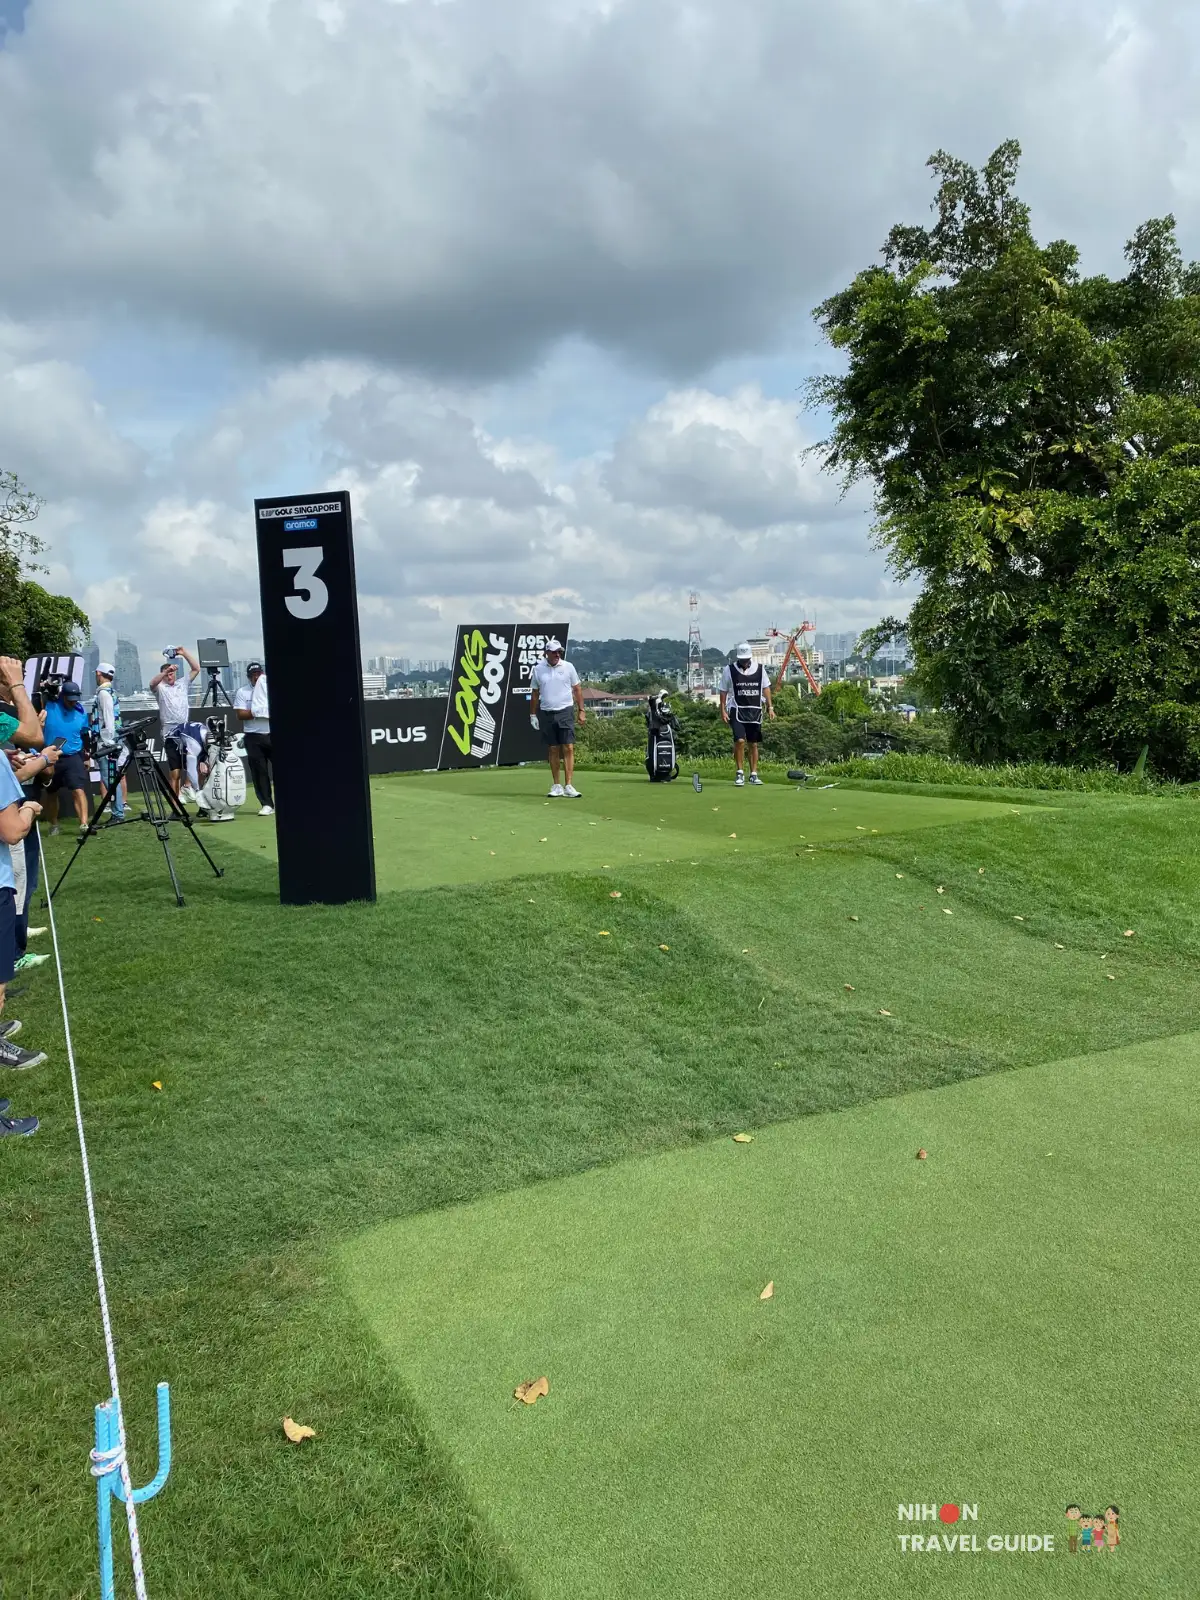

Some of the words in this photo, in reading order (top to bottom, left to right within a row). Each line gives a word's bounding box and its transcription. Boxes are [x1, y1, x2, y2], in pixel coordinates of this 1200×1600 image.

[275, 508, 293, 516] GOLF
[294, 503, 340, 515] SINGAPORE
[285, 520, 316, 529] aramco
[282, 546, 329, 620] 3
[518, 650, 549, 665] 453
[479, 632, 509, 705] GOLF
[370, 725, 427, 745] PLUS
[470, 698, 496, 759] LIV
